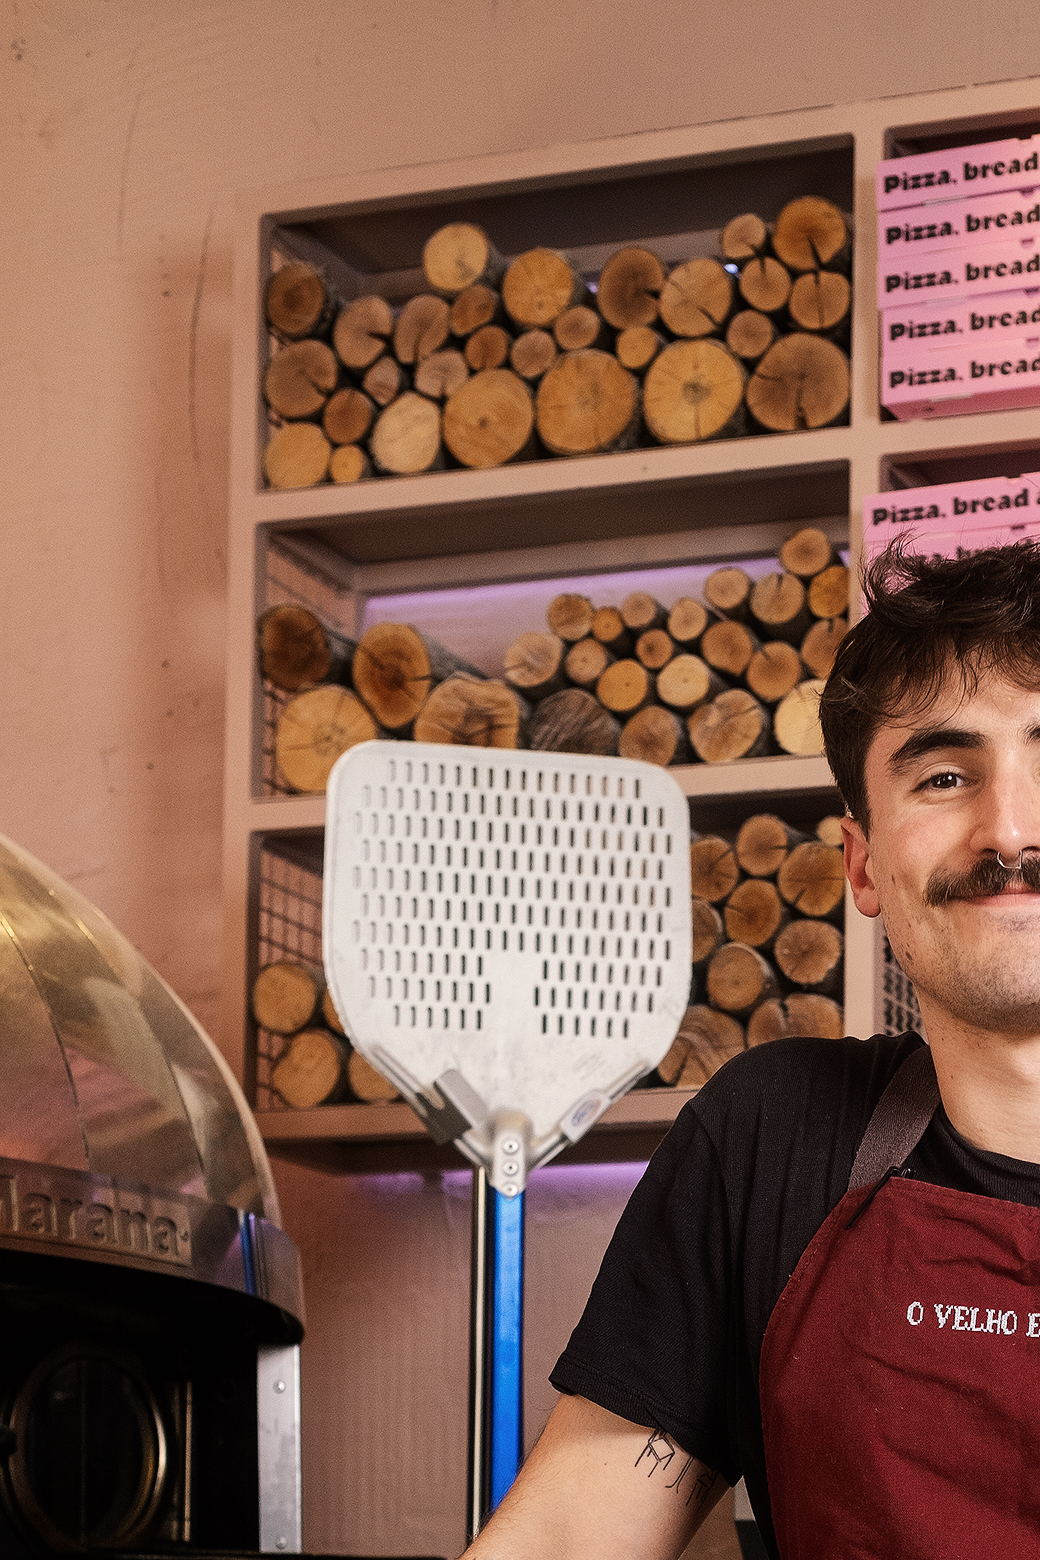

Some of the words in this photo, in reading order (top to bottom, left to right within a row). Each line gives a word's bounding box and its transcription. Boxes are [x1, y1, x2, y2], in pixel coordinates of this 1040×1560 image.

[964, 152, 1038, 181] bread
[966, 204, 1040, 232] bread
[966, 254, 1040, 281] bread
[953, 489, 1029, 515] bread
[906, 1301, 924, 1326] O
[934, 1303, 1018, 1335] VELHO
